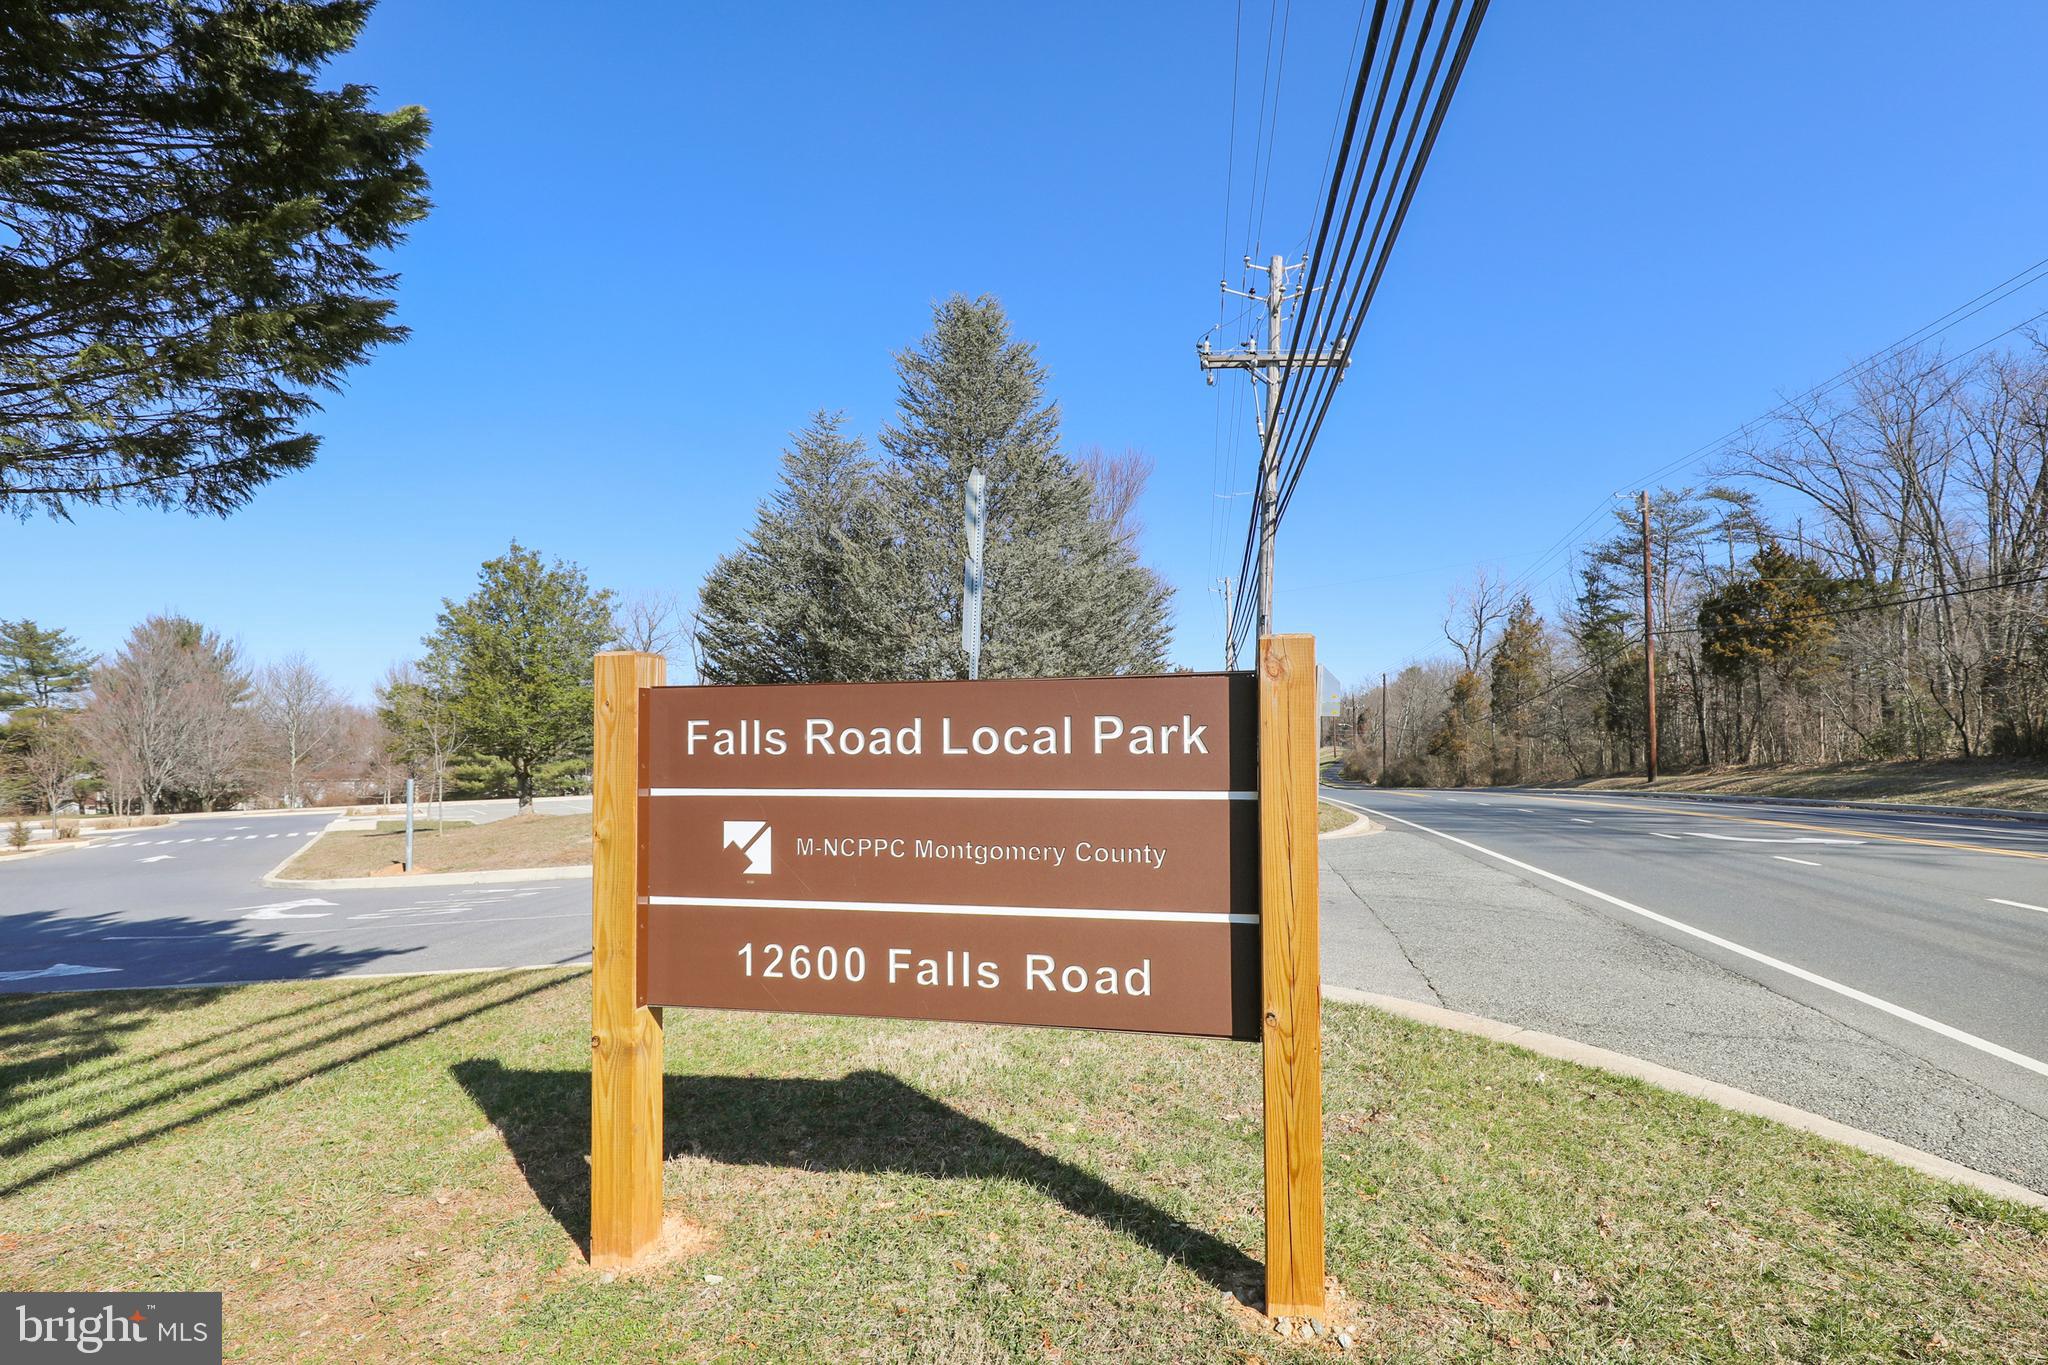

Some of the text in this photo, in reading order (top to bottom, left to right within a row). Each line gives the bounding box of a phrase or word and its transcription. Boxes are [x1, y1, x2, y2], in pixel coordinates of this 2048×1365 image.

[687, 715, 1209, 756] Falls Road Local Park
[796, 837, 1168, 870] M-NCPPC Montgomery County
[737, 943, 1151, 997] 12600 Falls Road
